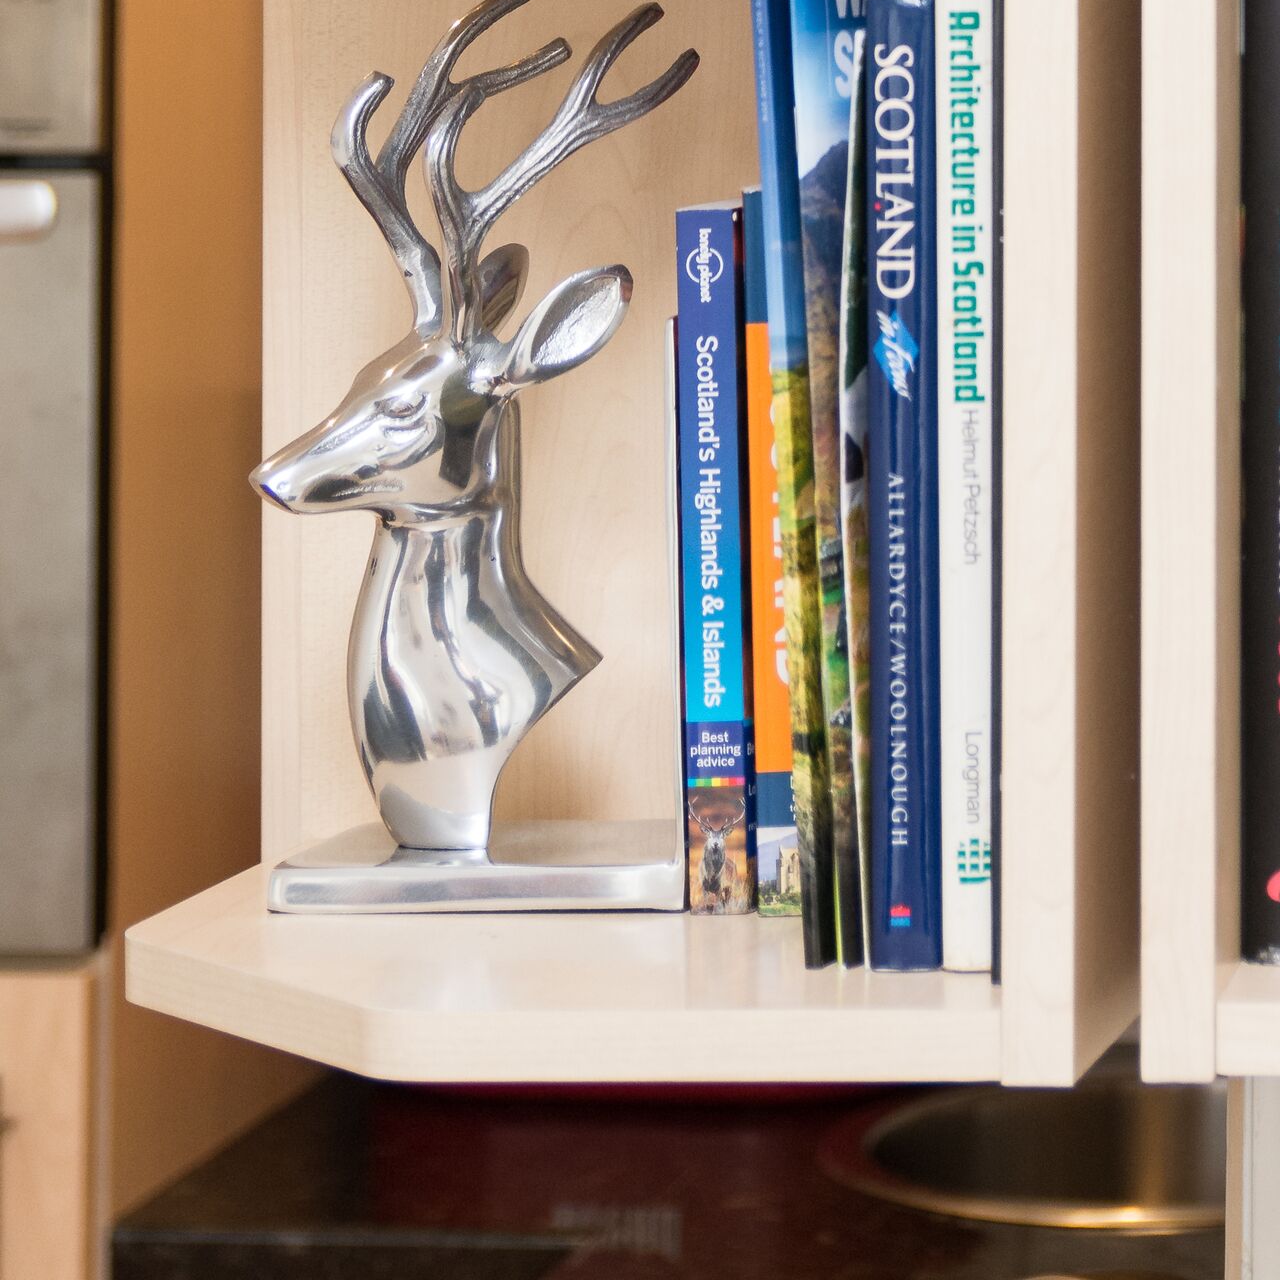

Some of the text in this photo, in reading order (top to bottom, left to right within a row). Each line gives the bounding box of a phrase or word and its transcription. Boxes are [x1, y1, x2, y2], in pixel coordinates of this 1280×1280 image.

[696, 227, 713, 303] lonely planet
[873, 43, 916, 402] SCOTLAND in Focus
[949, 11, 986, 402] Architecture in Scotland
[695, 335, 727, 708] Scotland's Highlands & Islands
[961, 409, 982, 565] Helmut Petzsch
[887, 473, 909, 847] ALLARDYCE/WOOLNOUGH
[690, 744, 742, 757] planning
[696, 756, 735, 767] advice
[701, 731, 729, 743] Best
[963, 731, 983, 824] Longman
